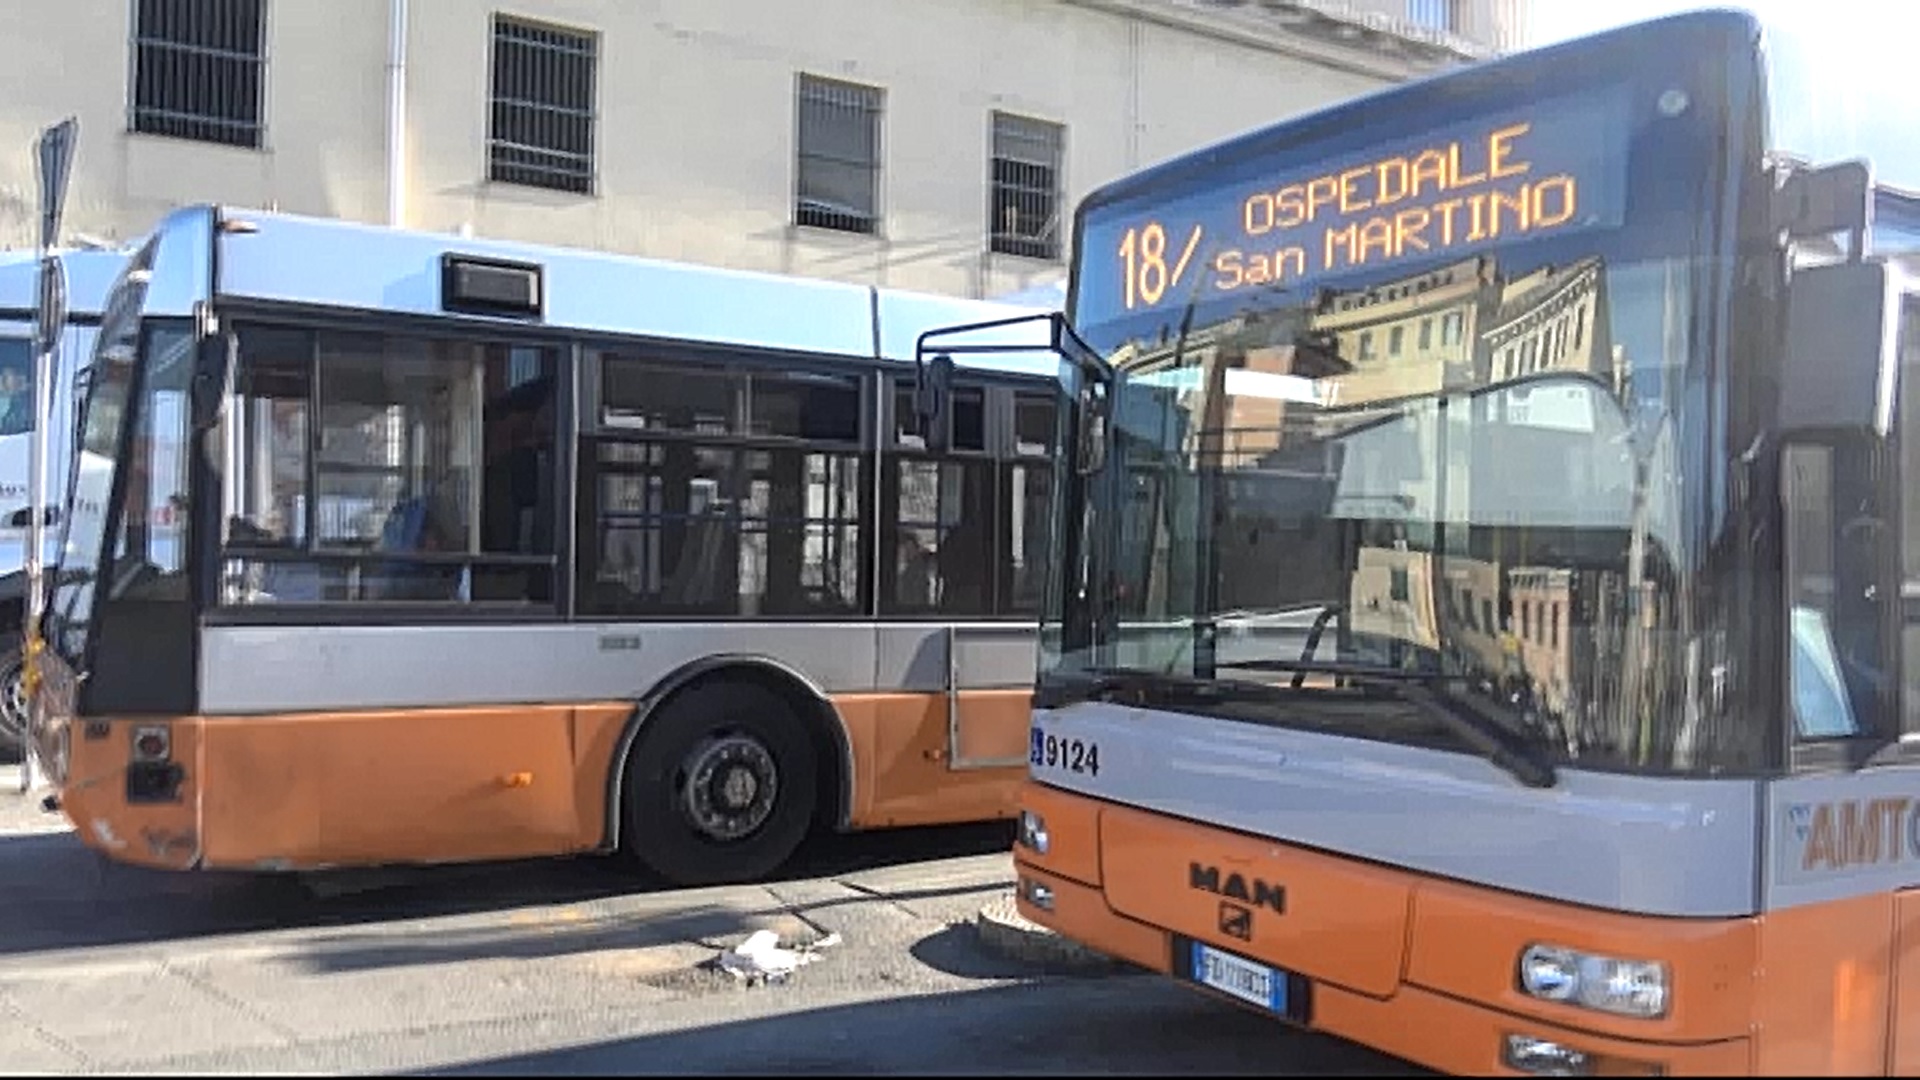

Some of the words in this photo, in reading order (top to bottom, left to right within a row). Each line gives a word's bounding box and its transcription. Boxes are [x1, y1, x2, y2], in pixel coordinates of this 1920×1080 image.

[1243, 122, 1532, 236] OSPEDALE
[1117, 222, 1202, 310] 18/
[1213, 245, 1305, 290] San
[1323, 174, 1576, 271] MARTINO
[1046, 735, 1099, 777] 9124
[1188, 861, 1288, 915] MAN
